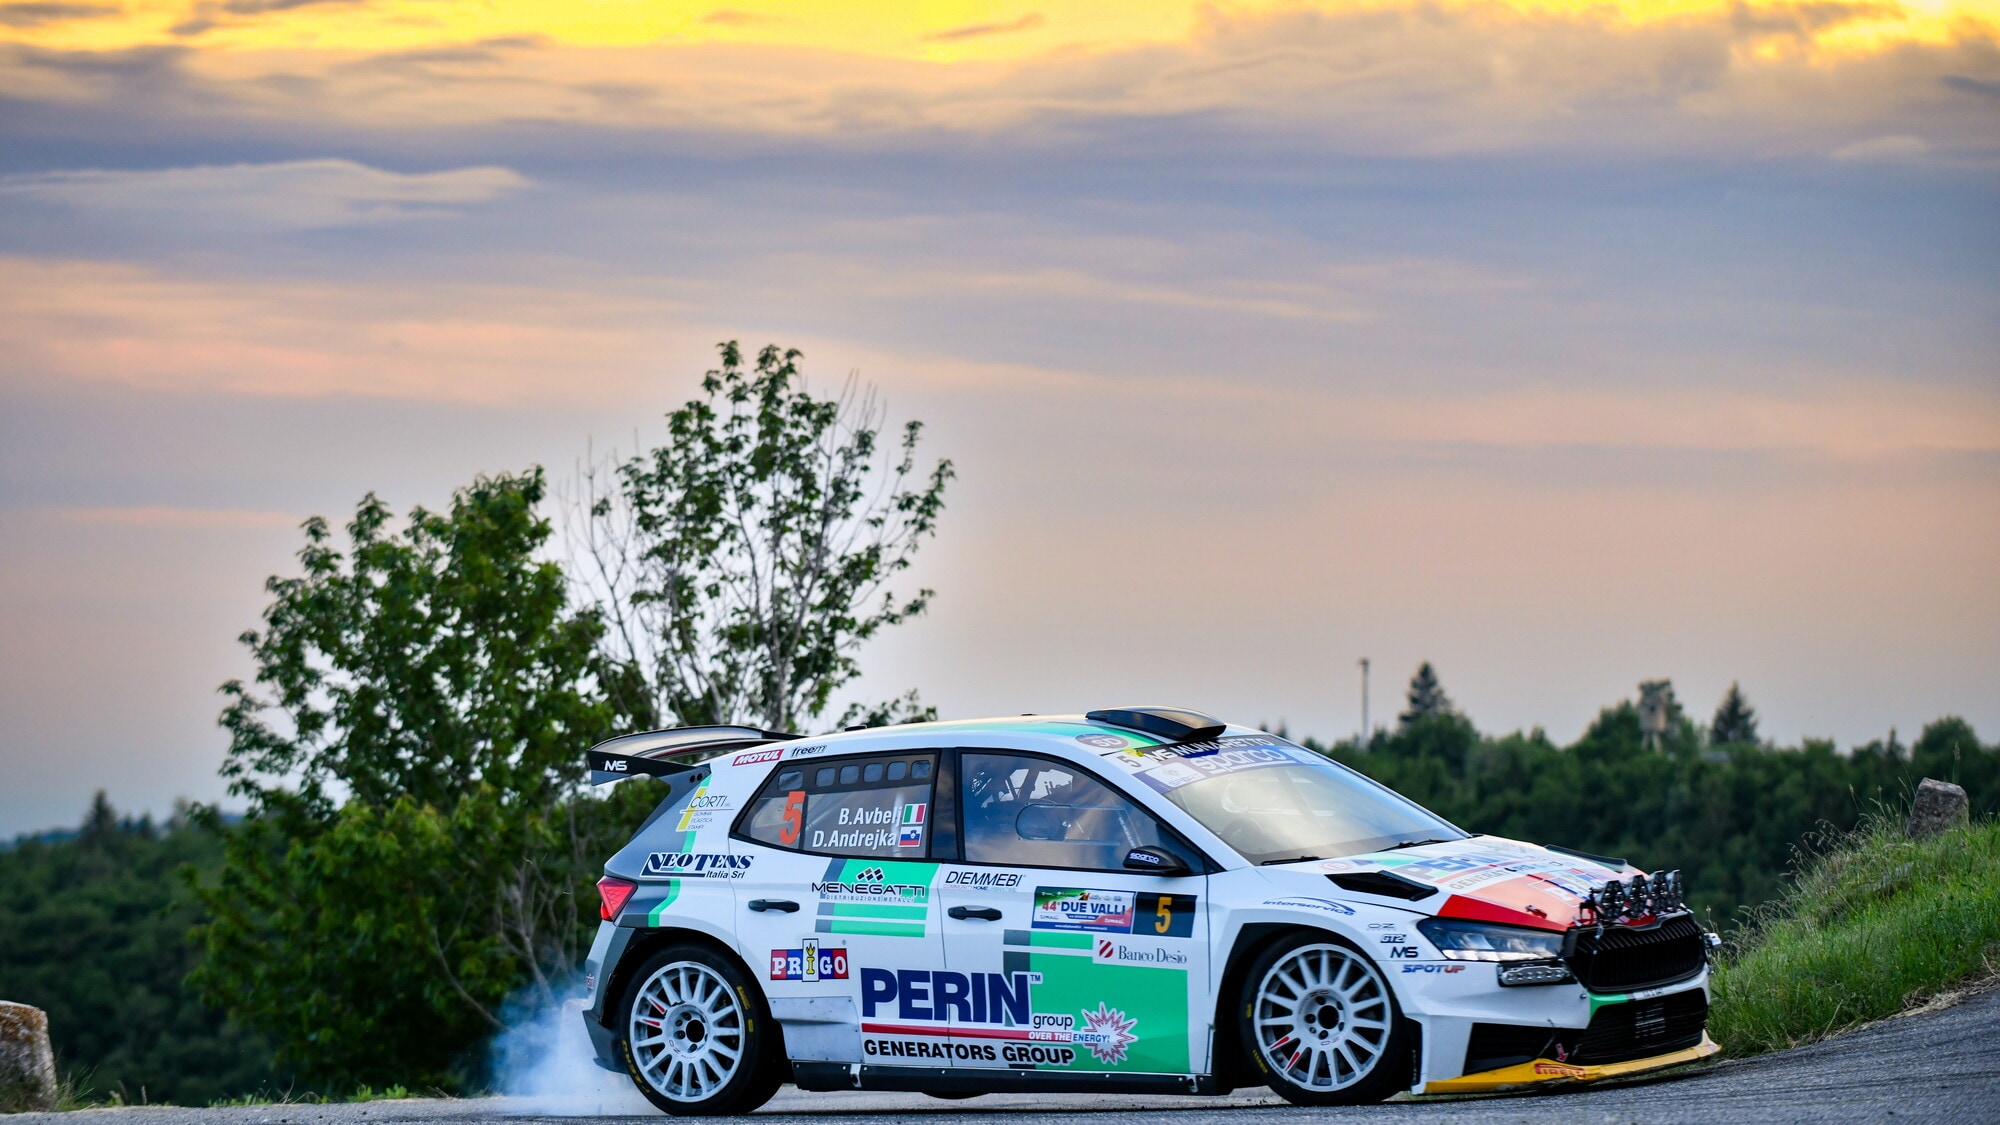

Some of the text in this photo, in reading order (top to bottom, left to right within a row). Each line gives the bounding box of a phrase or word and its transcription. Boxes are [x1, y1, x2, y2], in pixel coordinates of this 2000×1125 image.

[604, 760, 627, 771] MS
[735, 751, 779, 765] MOTUL
[1116, 755, 1142, 768] 5
[1190, 749, 1287, 774] sparco
[690, 795, 727, 808] CORTI
[780, 791, 806, 845] 5
[838, 807, 903, 828] B.Avbelj
[812, 820, 897, 851] D.Andrejka
[640, 854, 754, 877] NEOTENS
[1129, 852, 1159, 865] sparco
[705, 870, 745, 879] Italia Srl
[945, 871, 1023, 887] DIEMMEBI
[811, 882, 925, 897] MENEGATTI
[1061, 902, 1088, 913] DUE
[1090, 903, 1126, 915] VALLI
[1155, 896, 1172, 934] 5
[1262, 900, 1355, 917] interservice
[1118, 945, 1188, 964] Banco Desio
[1390, 946, 1418, 958] MS
[772, 956, 847, 975] PRIGO
[1401, 965, 1465, 973] SPOTUP
[860, 968, 1030, 1025] PERIN
[1033, 1014, 1073, 1029] group
[1028, 1032, 1111, 1043] OVER THE ENERGY!
[864, 1039, 1074, 1064] GENERATORS GROUP
